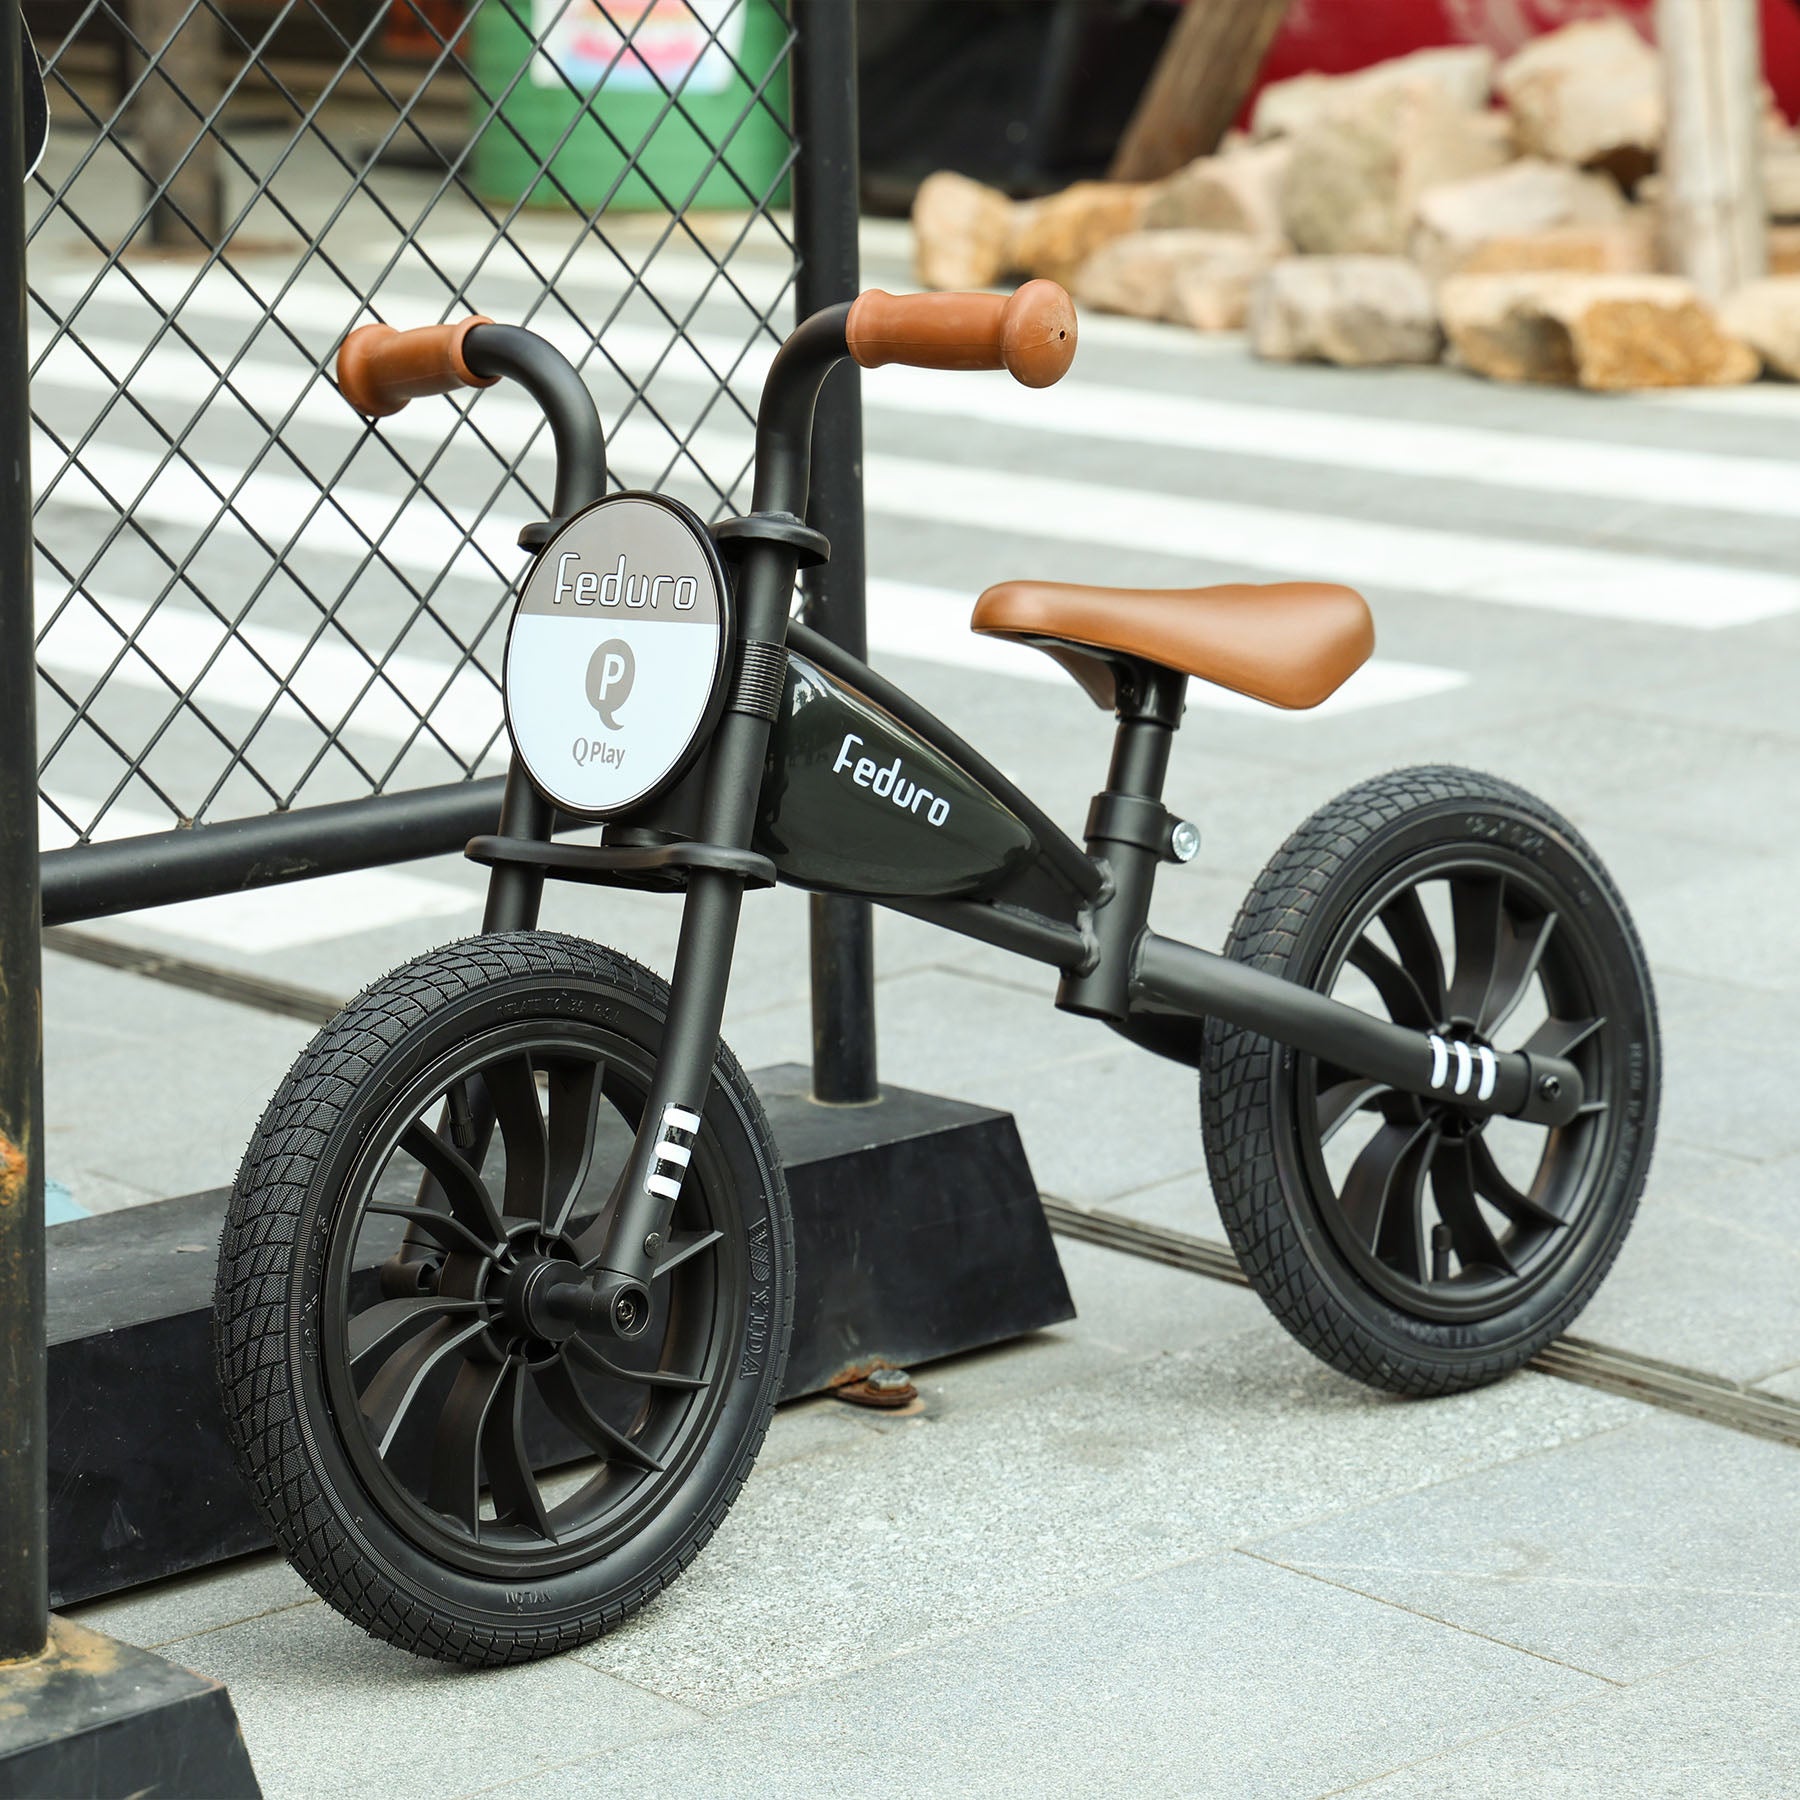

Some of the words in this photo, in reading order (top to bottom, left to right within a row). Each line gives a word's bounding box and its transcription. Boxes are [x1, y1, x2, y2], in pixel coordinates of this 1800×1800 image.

[553, 552, 698, 610] Feduro
[832, 733, 951, 827] Feduro
[739, 1286, 770, 1379] YIDA
